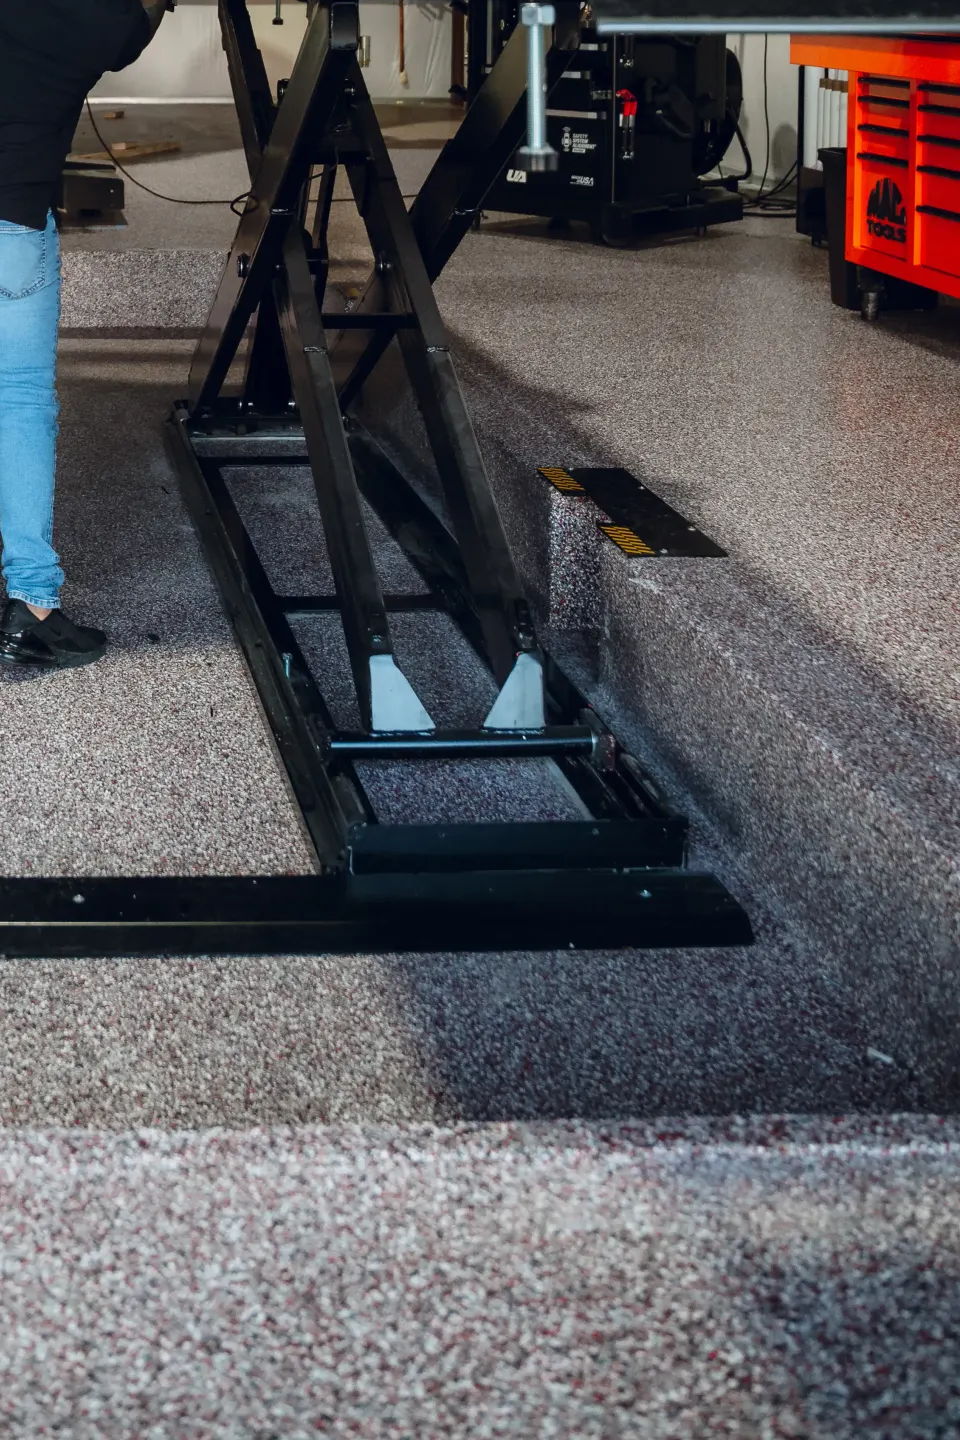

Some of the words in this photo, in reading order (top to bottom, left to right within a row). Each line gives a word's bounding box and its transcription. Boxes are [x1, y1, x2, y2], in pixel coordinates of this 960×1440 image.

[580, 176, 594, 185] USA
[867, 177, 907, 226] MAC
[867, 218, 907, 244] TOOLS
